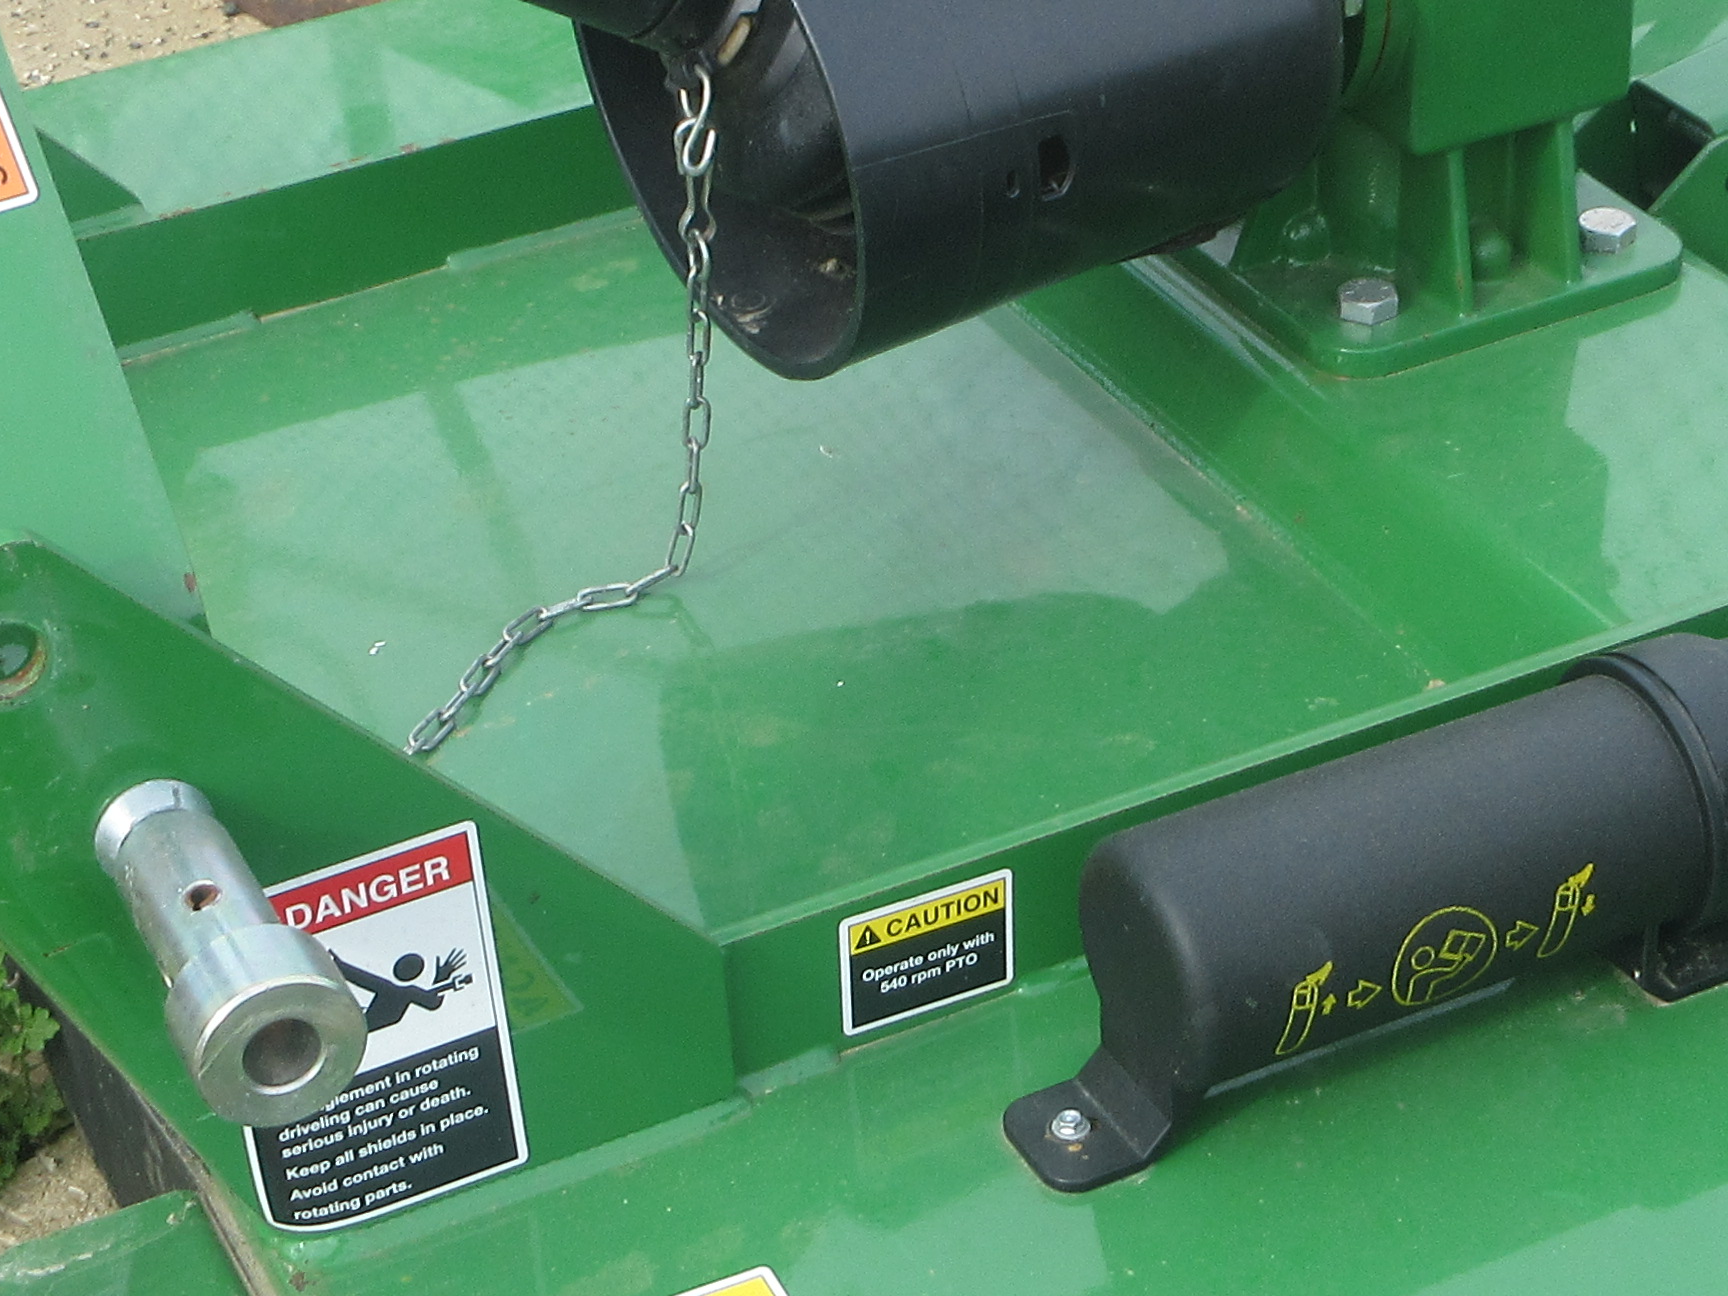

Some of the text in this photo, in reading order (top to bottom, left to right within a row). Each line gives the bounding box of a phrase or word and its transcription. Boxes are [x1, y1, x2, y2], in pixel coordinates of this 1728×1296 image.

[286, 855, 451, 931] DANGER
[885, 886, 999, 937] CAUTION
[862, 931, 994, 983] Operate only with
[880, 952, 978, 993] 540 rpm PTO
[322, 1046, 478, 1111] glement in rotating
[354, 1098, 385, 1115] can
[389, 1079, 438, 1103] cause
[282, 1086, 470, 1158] serious injury or death.
[285, 1106, 488, 1180] Keep all shields in place.
[290, 1143, 443, 1201] Avoid contact with
[294, 1181, 411, 1222] rotating parts.
